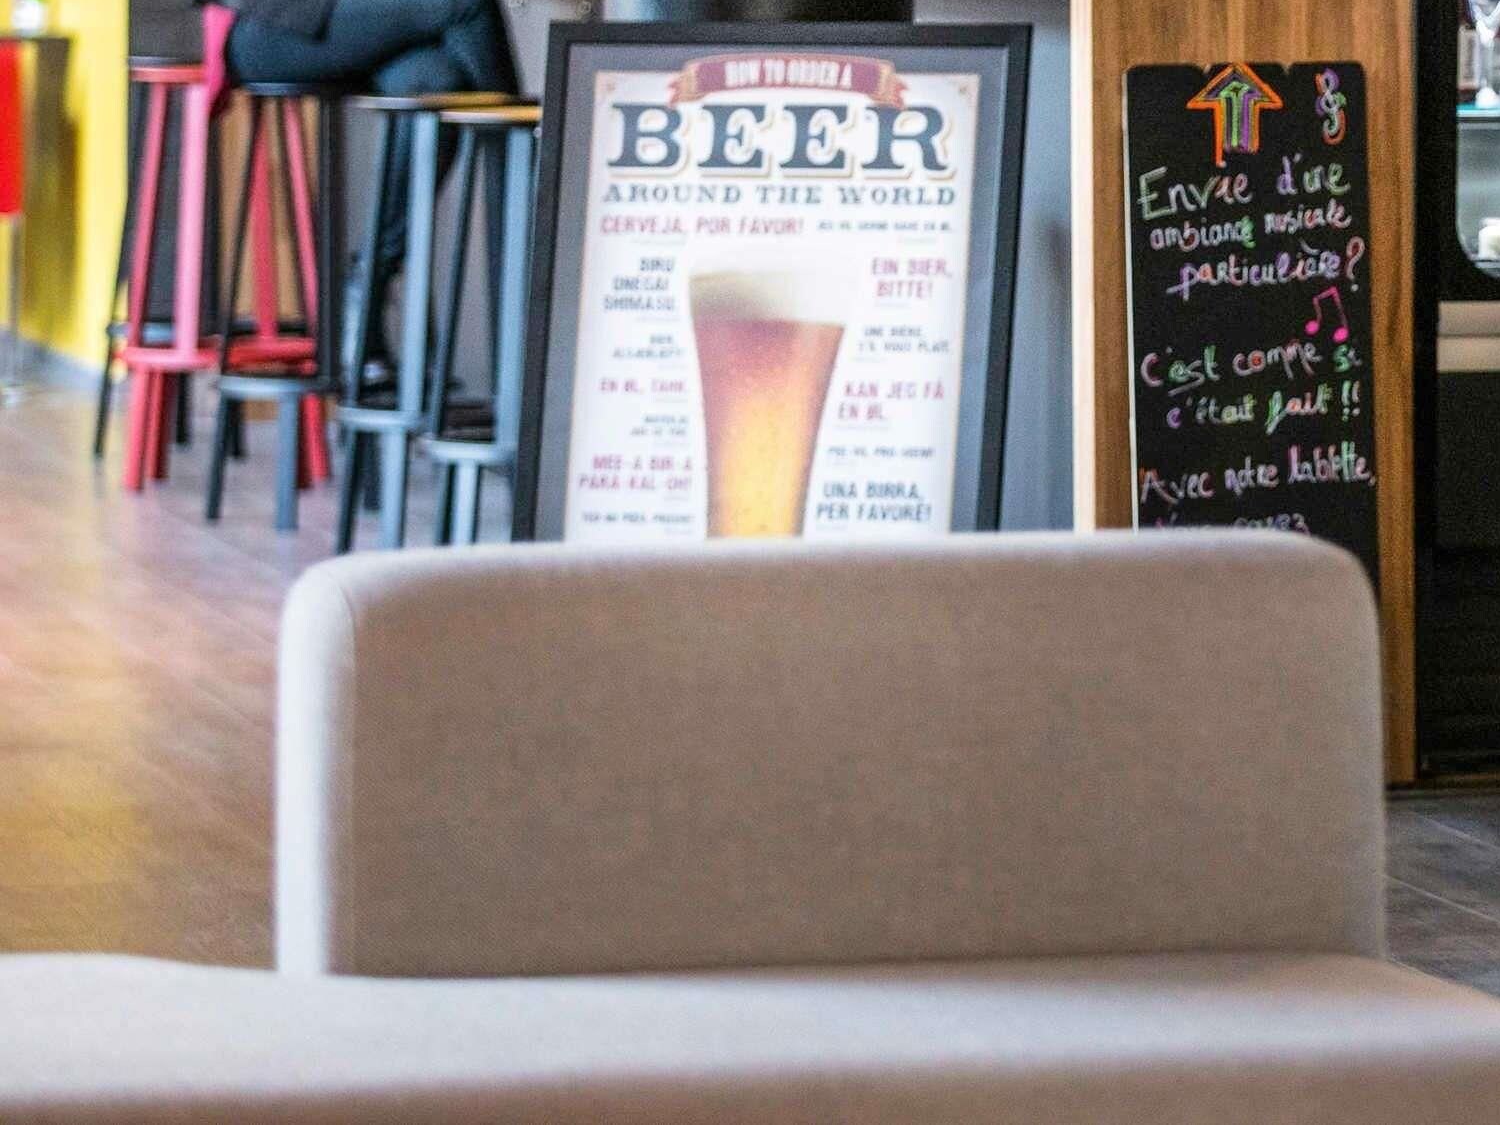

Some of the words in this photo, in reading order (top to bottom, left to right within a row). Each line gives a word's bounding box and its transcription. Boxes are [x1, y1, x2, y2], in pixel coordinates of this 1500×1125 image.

[607, 103, 950, 172] BEER
[602, 184, 742, 204] AROUND
[755, 185, 822, 205] THE
[838, 185, 956, 206] WORLD
[1136, 165, 1252, 220] Envie
[1139, 466, 1215, 505] Avec
